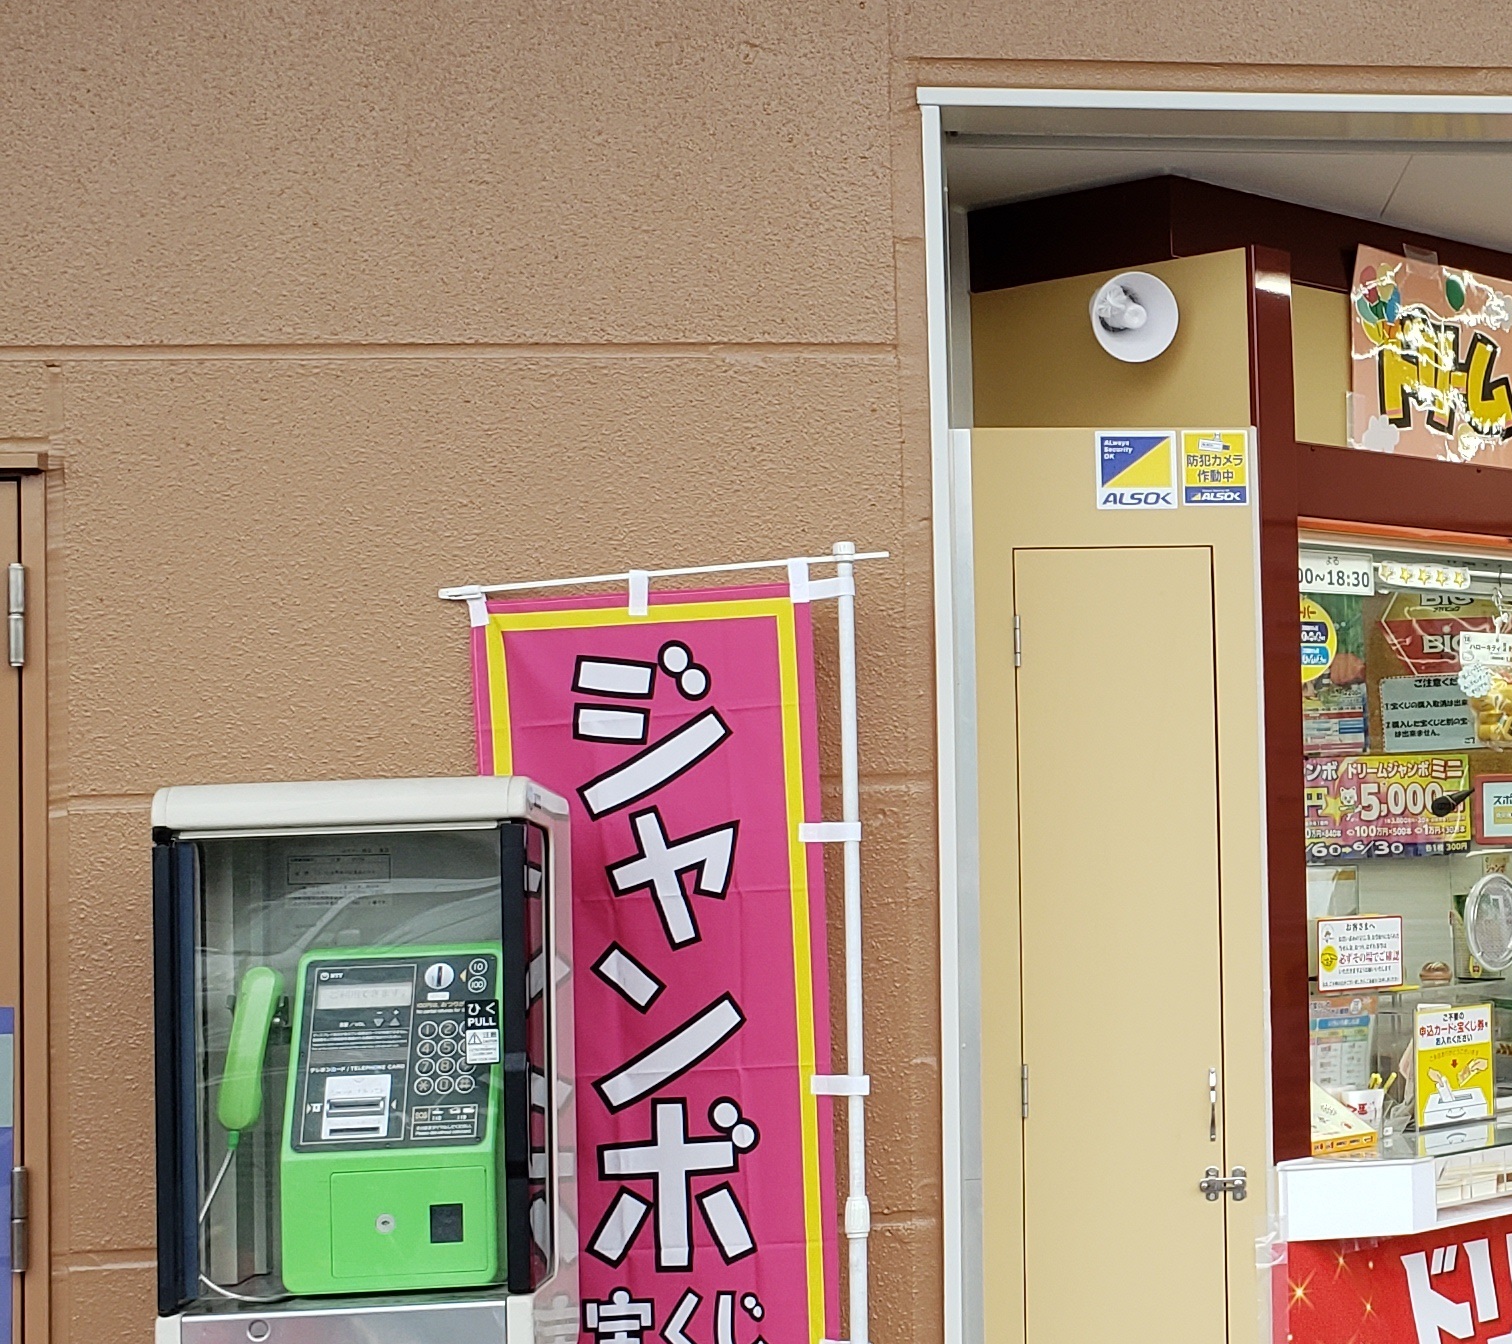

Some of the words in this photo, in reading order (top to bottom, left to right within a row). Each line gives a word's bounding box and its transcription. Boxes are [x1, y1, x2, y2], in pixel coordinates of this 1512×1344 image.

[1187, 454, 1243, 468] 防犯カメラ
[1197, 469, 1234, 483] 作動中
[1102, 492, 1172, 506] ALSOK
[1201, 492, 1241, 501] ALSOK
[572, 640, 759, 1274] ジャンボ
[467, 1002, 496, 1016] ひく
[467, 1016, 497, 1027] PULL
